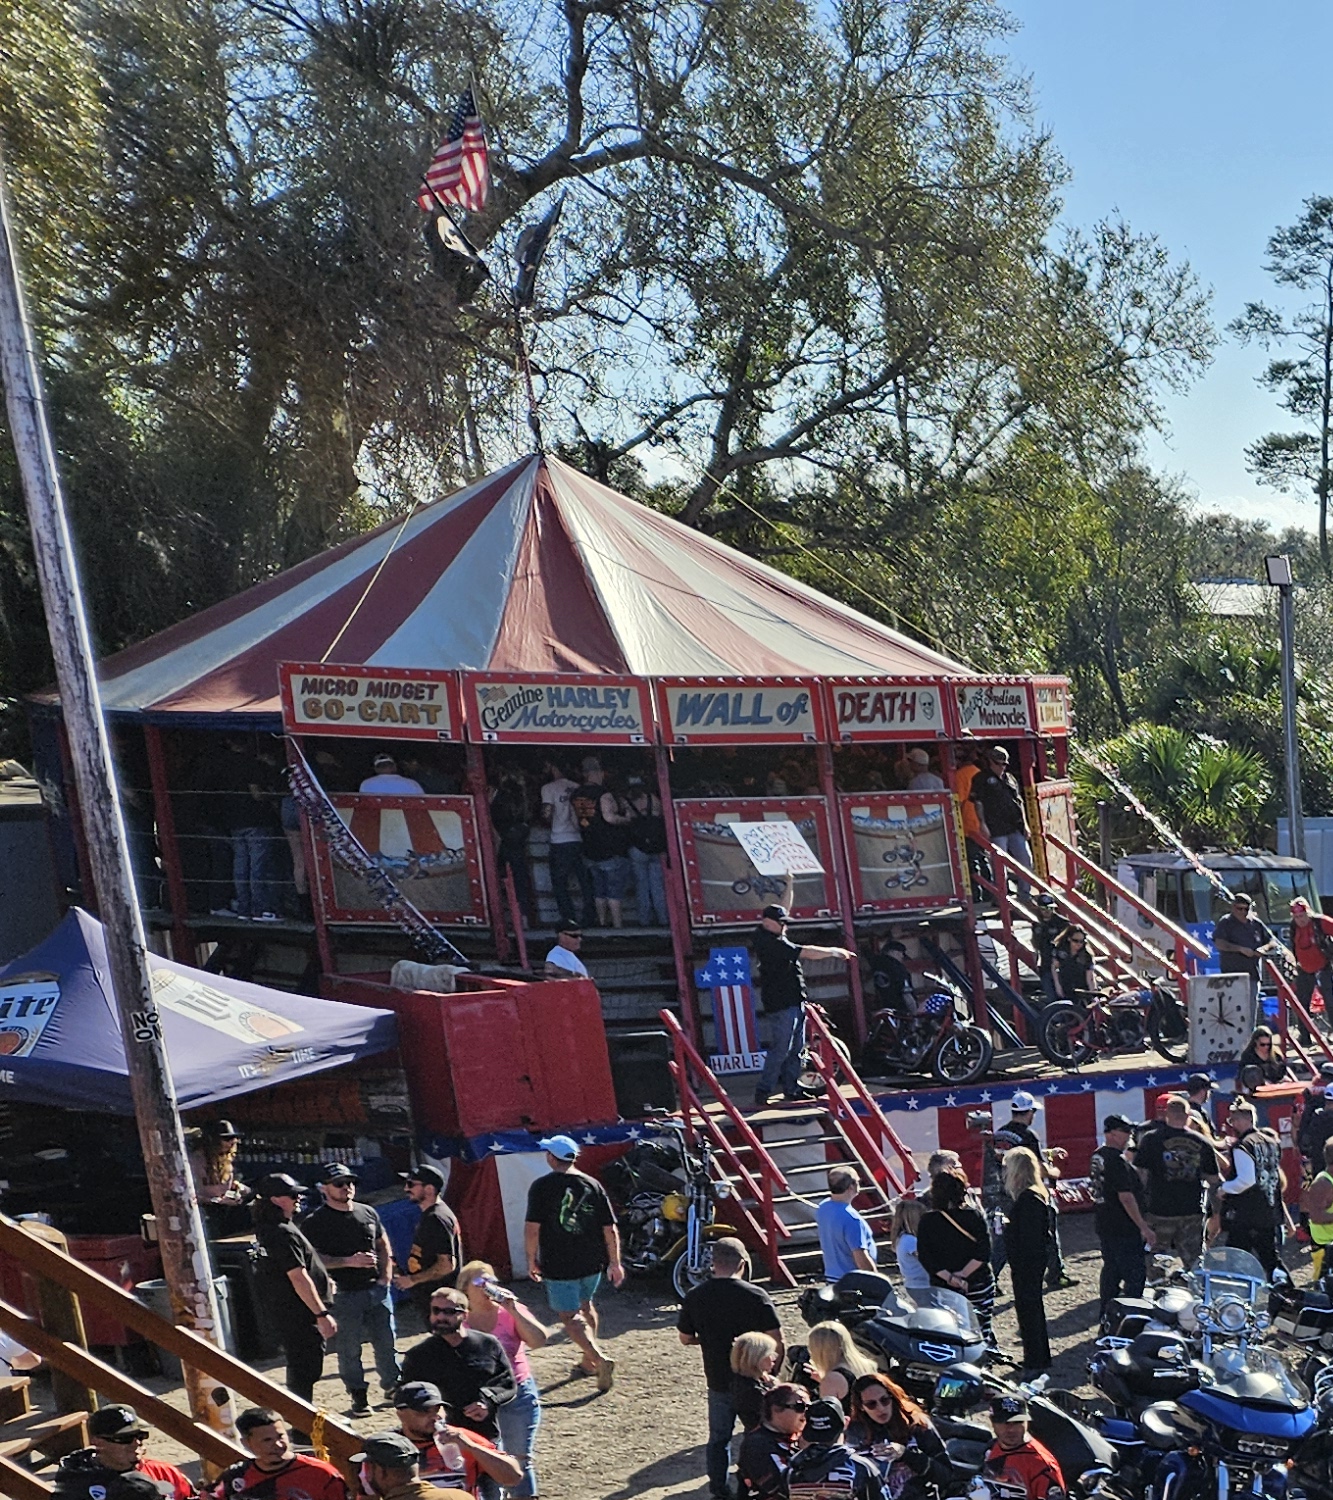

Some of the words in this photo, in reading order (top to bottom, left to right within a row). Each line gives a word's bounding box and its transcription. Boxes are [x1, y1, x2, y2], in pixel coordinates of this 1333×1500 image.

[301, 677, 358, 696] MICRO
[365, 680, 439, 700] MIDGET
[984, 686, 1022, 707] Indian
[303, 698, 442, 726] GO-CART
[481, 685, 544, 730] Genuine
[547, 686, 631, 710] HARLEY
[509, 704, 640, 732] Motorcycles
[675, 691, 774, 727] WALL
[776, 692, 810, 726] of
[837, 691, 918, 725] DEATH
[0, 993, 59, 1020] ite
